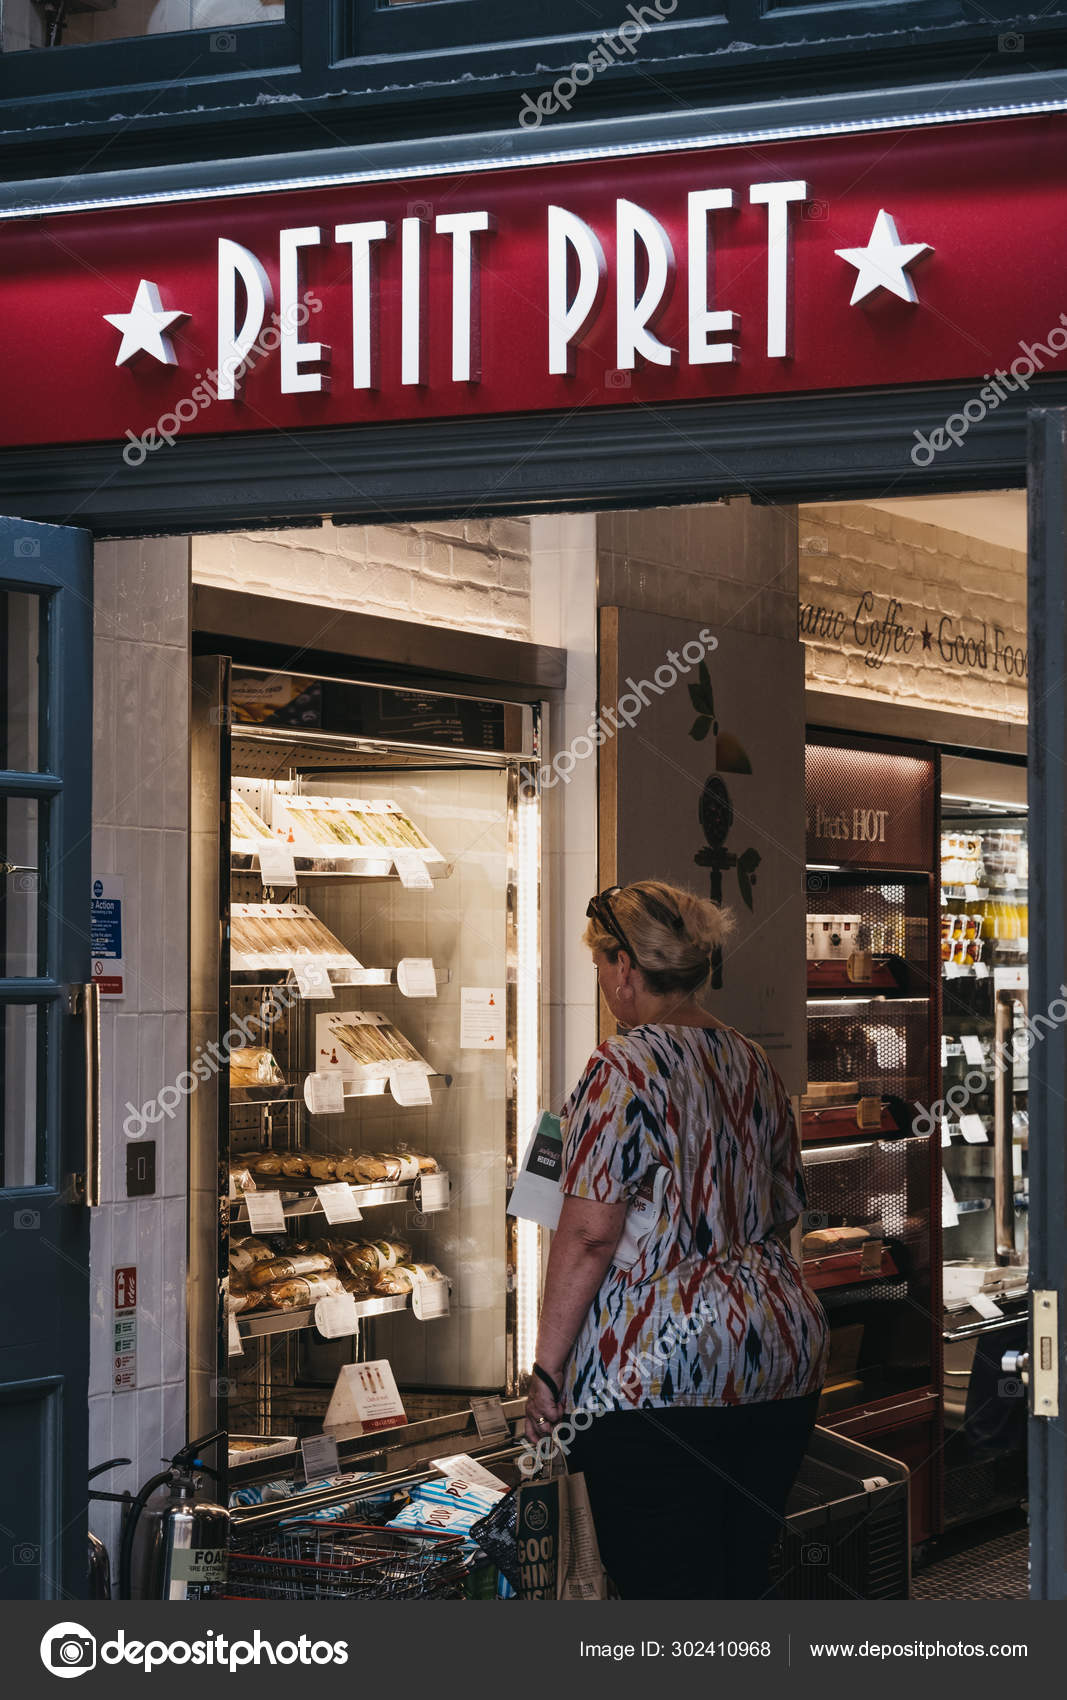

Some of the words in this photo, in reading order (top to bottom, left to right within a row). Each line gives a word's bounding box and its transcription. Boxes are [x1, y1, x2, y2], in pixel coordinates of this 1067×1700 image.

[218, 211, 491, 400] PETIT
[548, 180, 808, 375] PRET
[799, 602, 846, 640] anic
[853, 591, 915, 670] Coffee
[938, 616, 987, 670] Good
[993, 624, 1029, 678] Foo
[853, 808, 889, 842] HOT
[95, 900, 115, 910] Action
